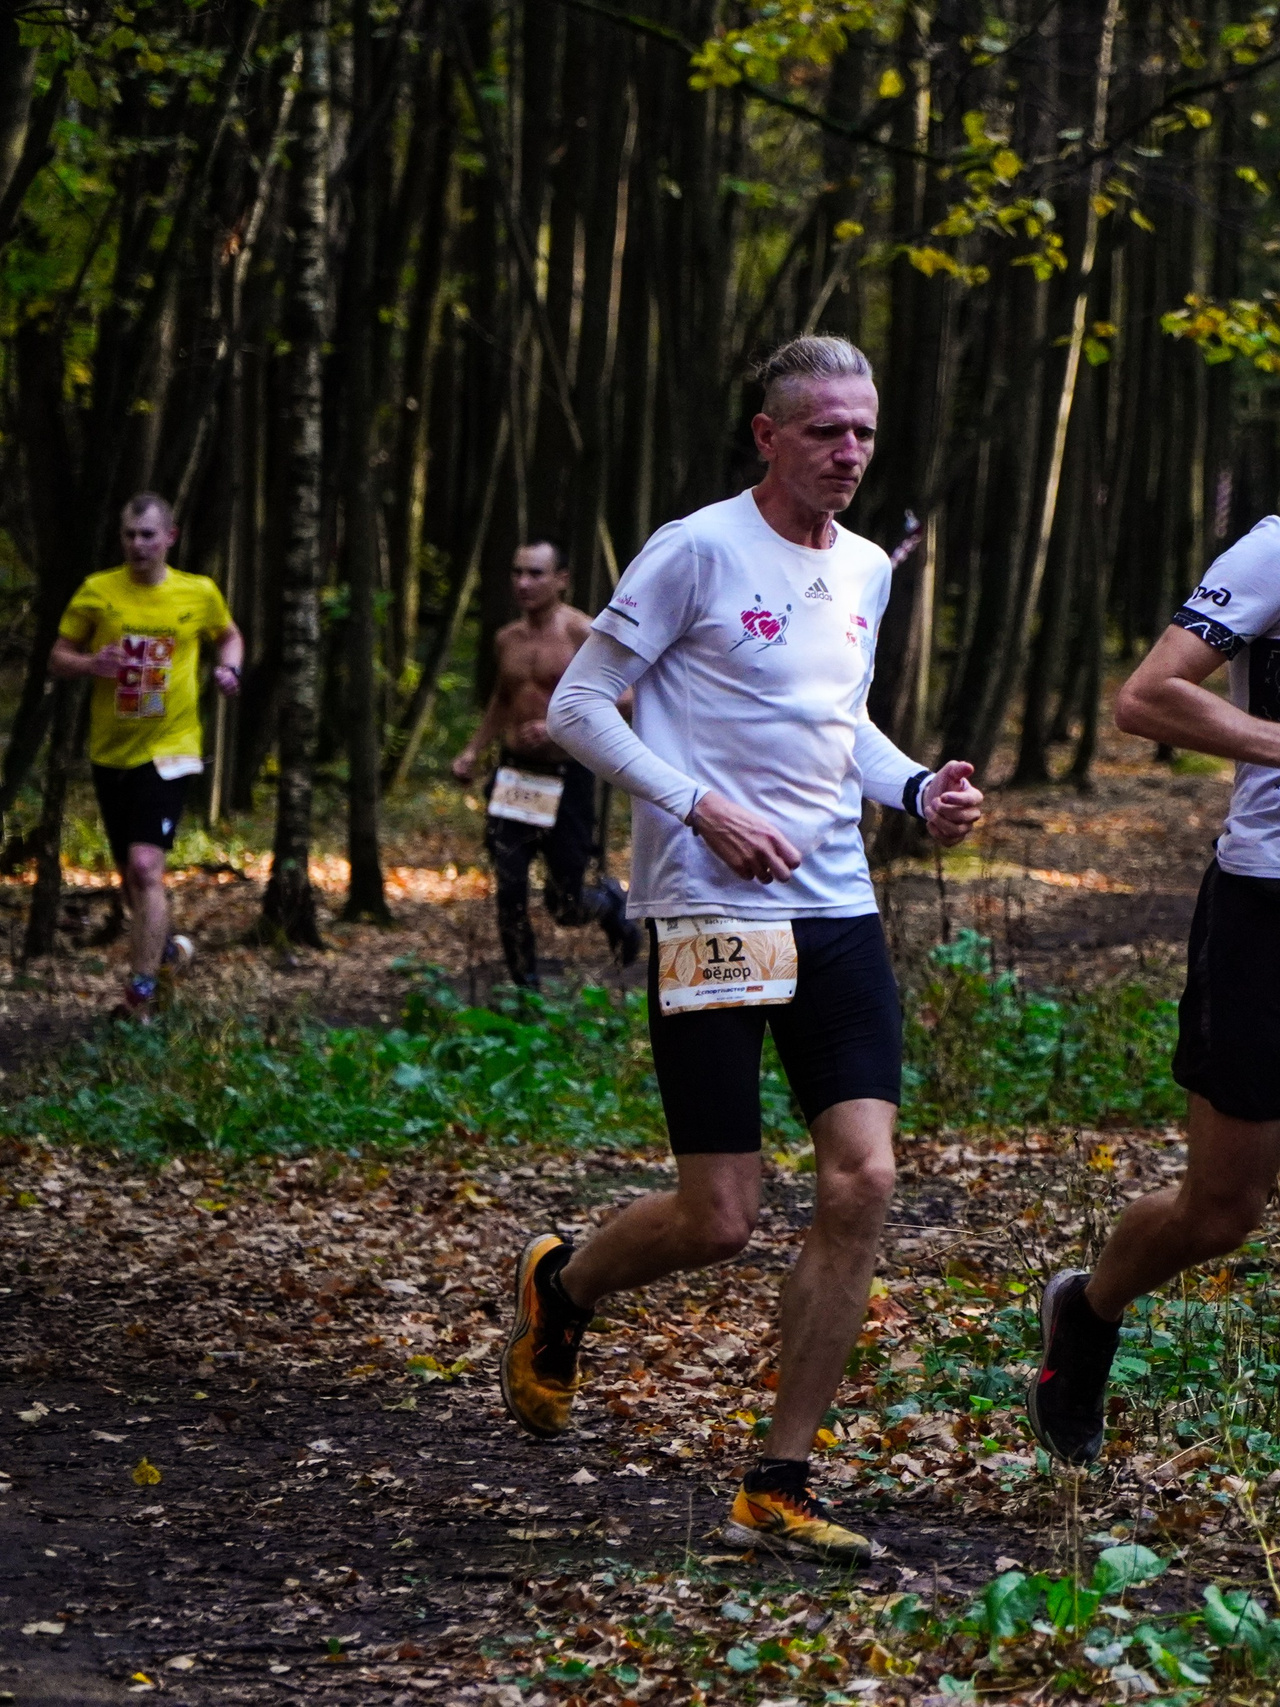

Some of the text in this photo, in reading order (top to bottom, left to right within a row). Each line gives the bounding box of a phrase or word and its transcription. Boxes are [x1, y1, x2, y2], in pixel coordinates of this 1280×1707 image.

[805, 591, 832, 601] adidas
[705, 936, 746, 964] 12
[702, 966, 752, 981] Фёдор
